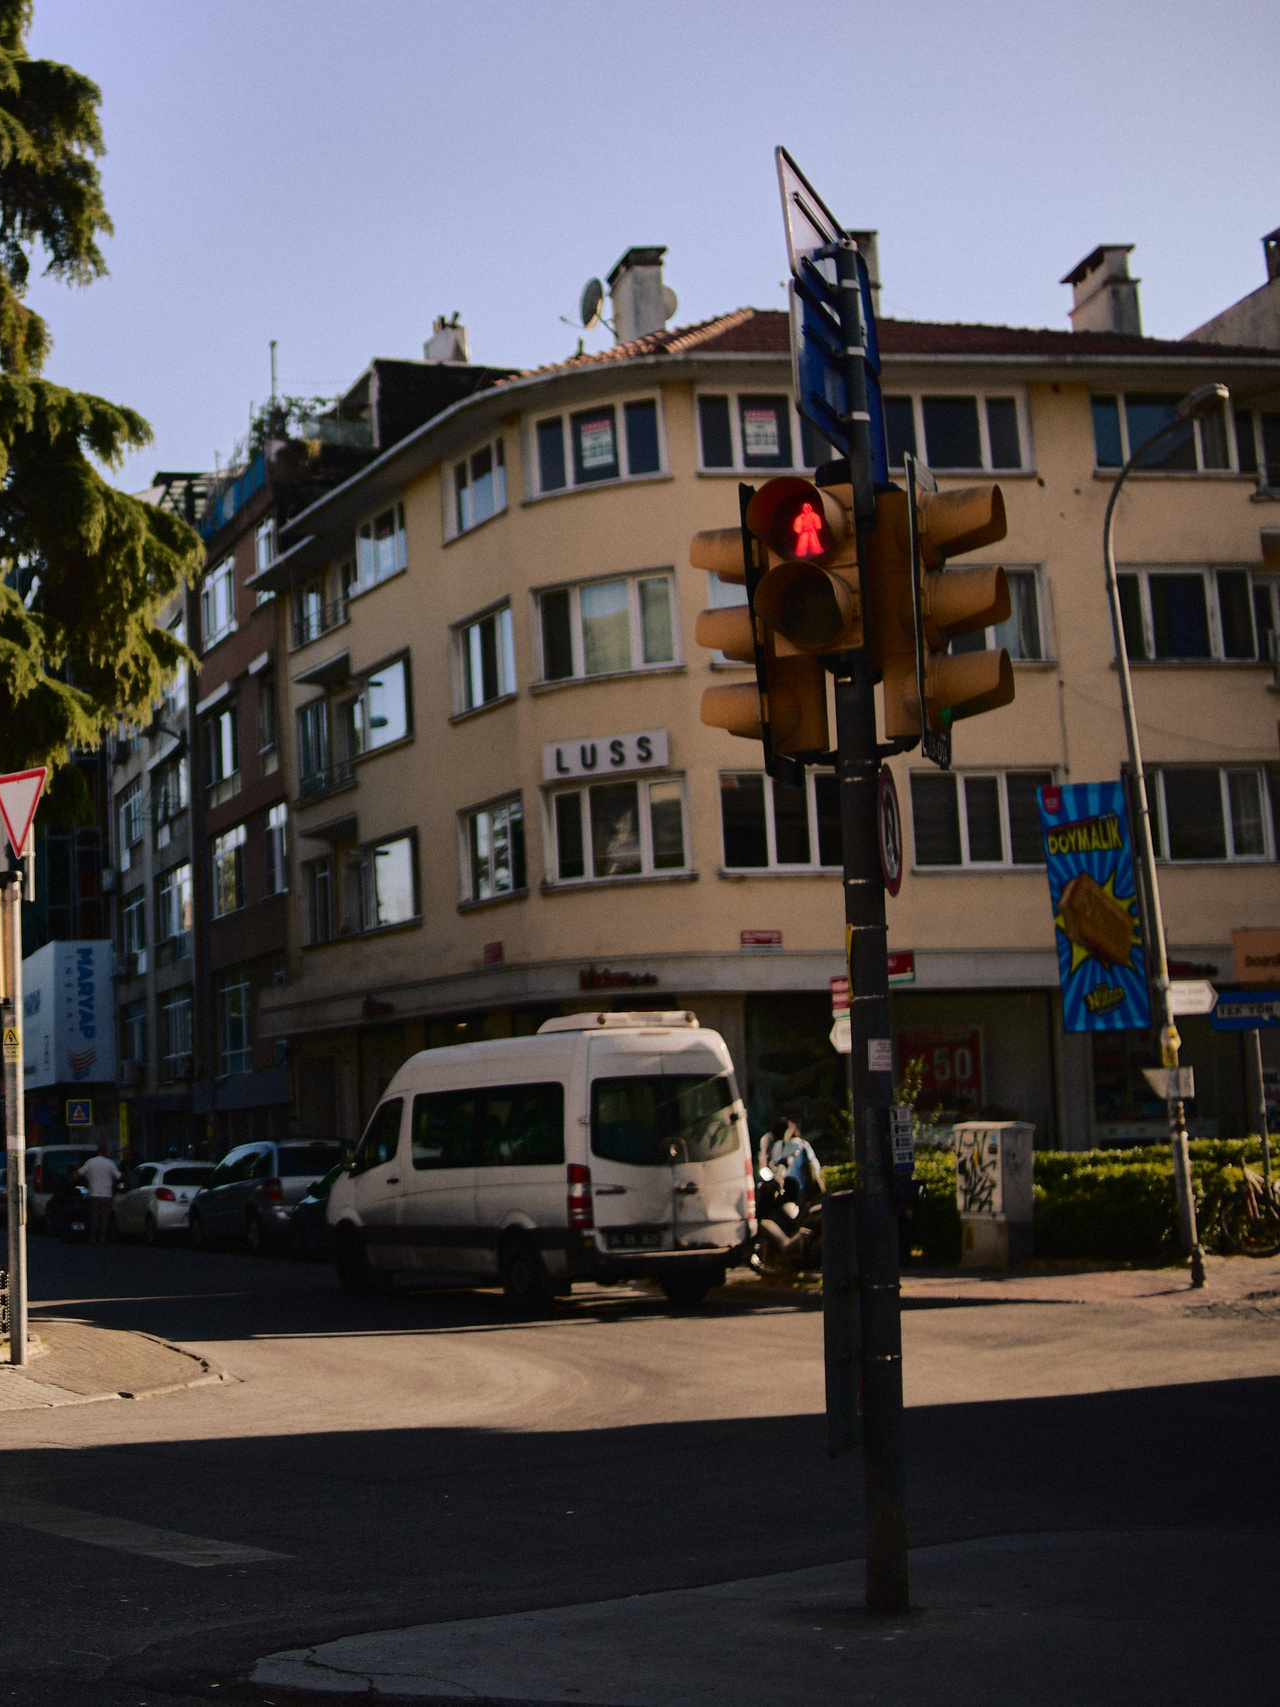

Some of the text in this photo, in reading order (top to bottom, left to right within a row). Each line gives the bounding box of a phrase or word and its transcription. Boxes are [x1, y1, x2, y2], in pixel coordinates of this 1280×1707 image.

[555, 735, 653, 774] LUSS
[1047, 817, 1122, 854] DOYMALIK
[76, 948, 96, 1039] MARYAP
[1218, 1004, 1242, 1015] TEK
